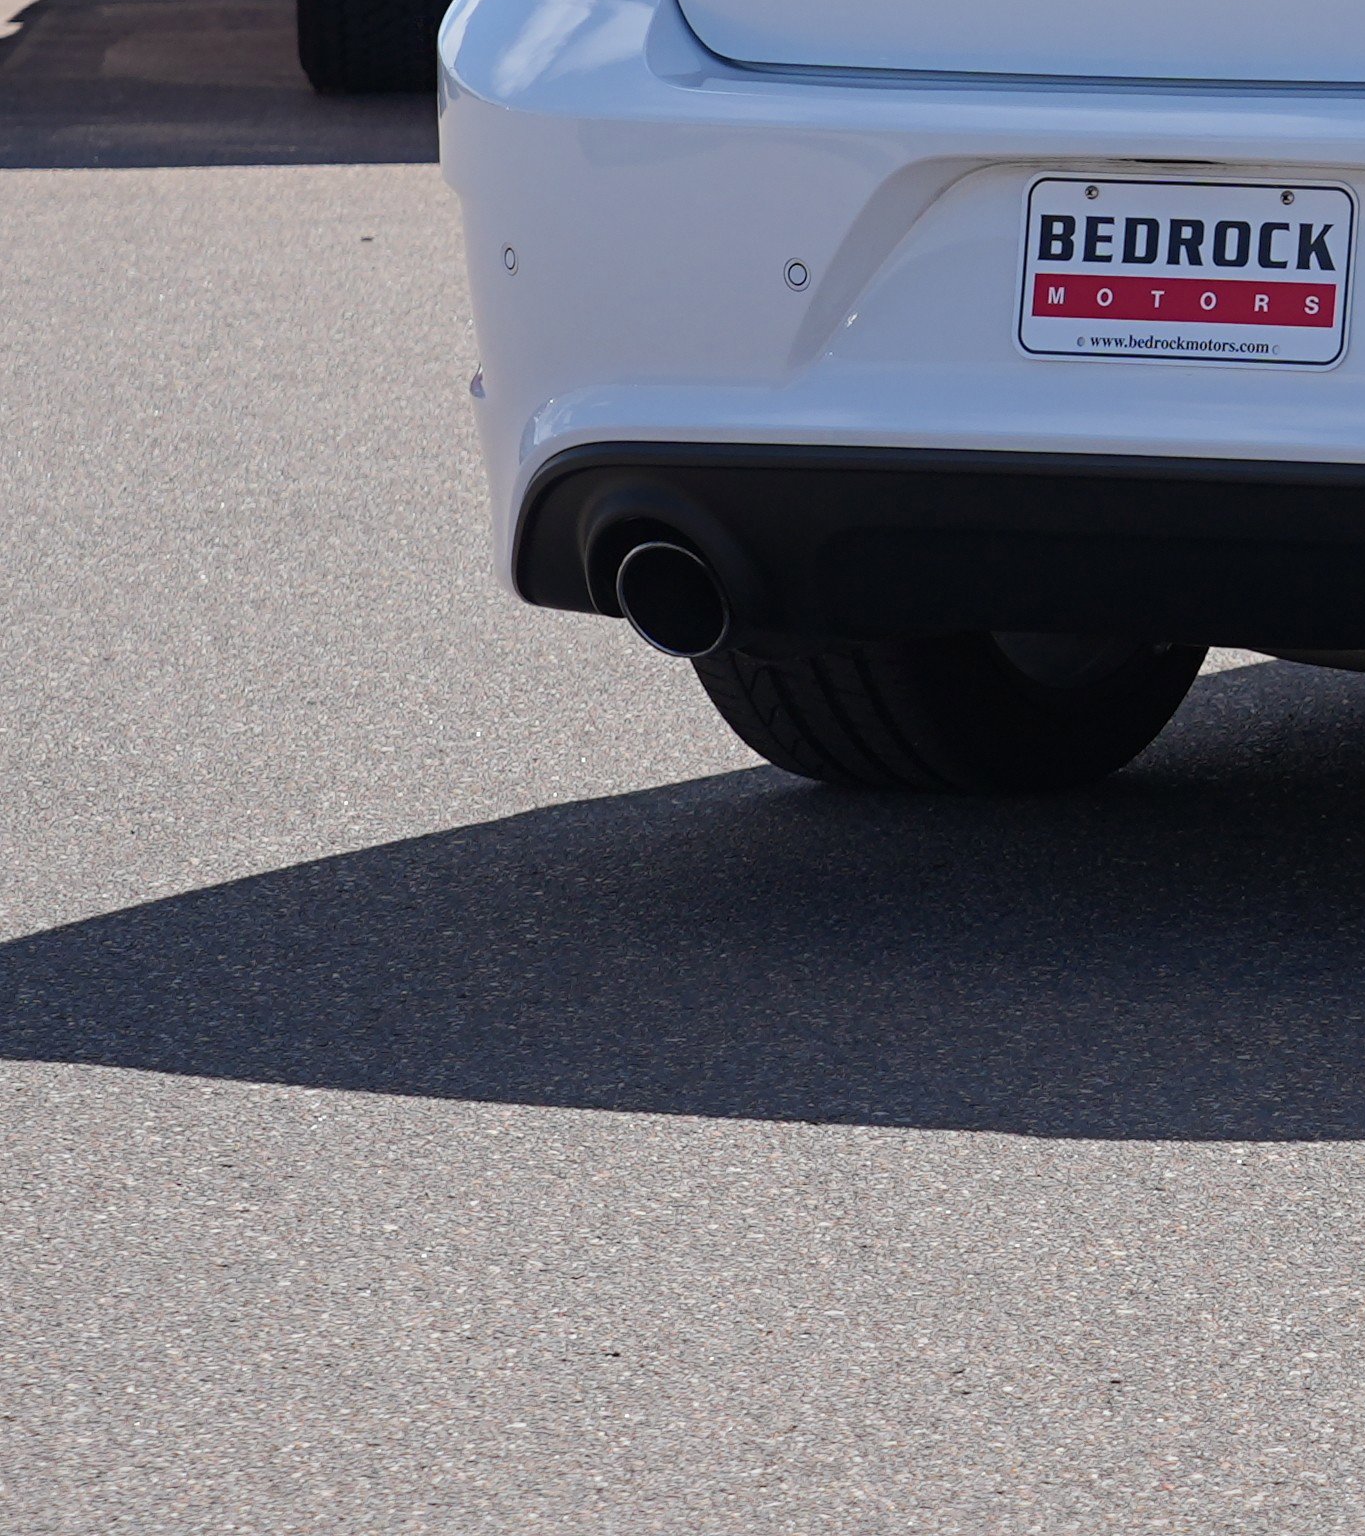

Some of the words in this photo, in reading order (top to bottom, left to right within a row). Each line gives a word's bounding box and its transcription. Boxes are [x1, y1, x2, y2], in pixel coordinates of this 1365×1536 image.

[1037, 214, 1337, 272] BEDROCK
[1047, 286, 1320, 316] MOTORS
[1089, 333, 1270, 355] www.bedrockmotors.com
